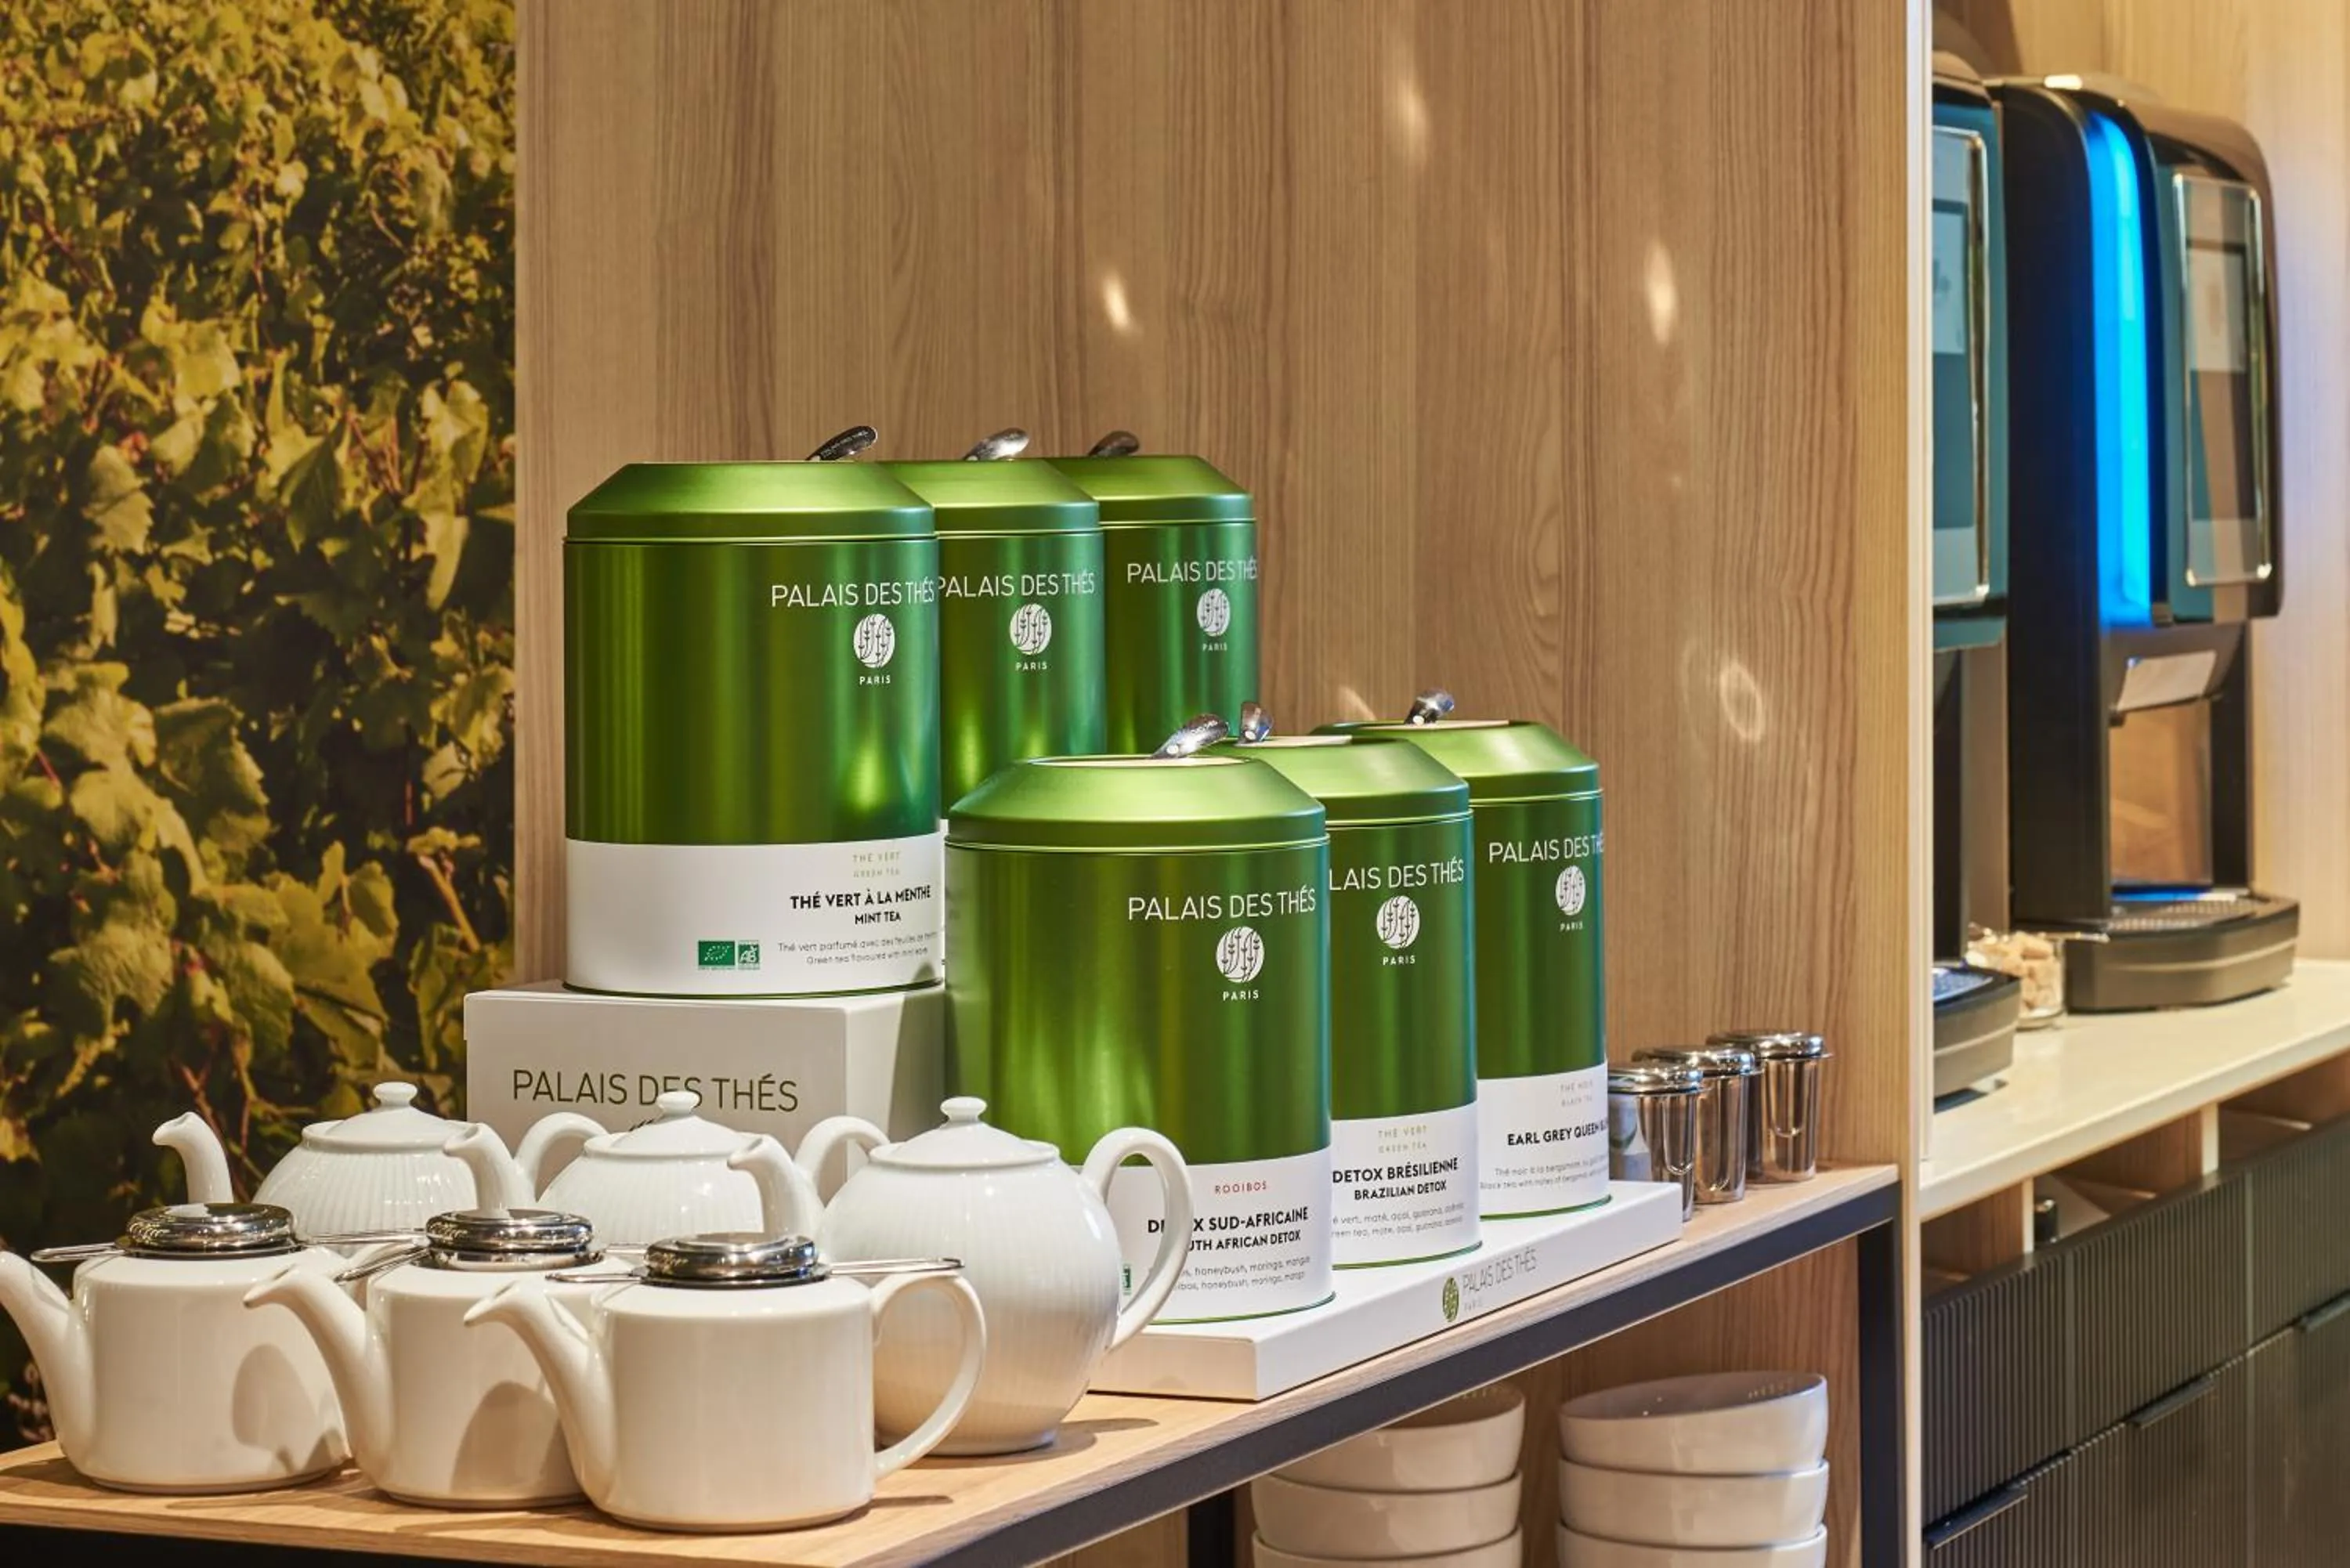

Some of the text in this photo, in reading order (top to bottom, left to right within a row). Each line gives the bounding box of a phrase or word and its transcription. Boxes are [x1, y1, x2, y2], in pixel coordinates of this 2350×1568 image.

[1126, 562, 1201, 583] PALAIS
[1206, 561, 1235, 582] DES
[771, 576, 935, 608] PALAIS DES THÉS
[938, 569, 1095, 598] PALAIS DES THÉS
[1202, 642, 1227, 651] PARIS
[1015, 661, 1047, 670] PARIS
[859, 675, 891, 685] PARIS
[1488, 840, 1560, 863] PALAIS
[1564, 836, 1589, 859] DES
[1329, 856, 1464, 891] LAIS DES THÉS
[790, 891, 821, 909] THÉ
[826, 893, 861, 907] VERT
[877, 891, 892, 904] LA
[895, 884, 931, 902] MENTHE
[1128, 885, 1316, 920] PALAIS DES THÉS
[855, 911, 902, 924] MINT TEA
[1560, 921, 1583, 931] PARIS
[1383, 956, 1415, 965] PARIS
[1222, 989, 1260, 1001] PARIS
[512, 1069, 627, 1106] PALAIS
[710, 1073, 799, 1112] THÉS
[1507, 1131, 1540, 1146] EARL
[1542, 1127, 1572, 1143] GREY
[1332, 1158, 1459, 1183] DETOX BRÉSILIENNE
[1215, 1180, 1267, 1194] ROOIBOS
[1354, 1180, 1447, 1201] BRAZILIAN DETOX
[1209, 1206, 1309, 1231] SUD-AFRICAINE
[1216, 1234, 1268, 1250] AFRICAN
[1270, 1230, 1301, 1245] DETOX
[1331, 1229, 1351, 1237] reen
